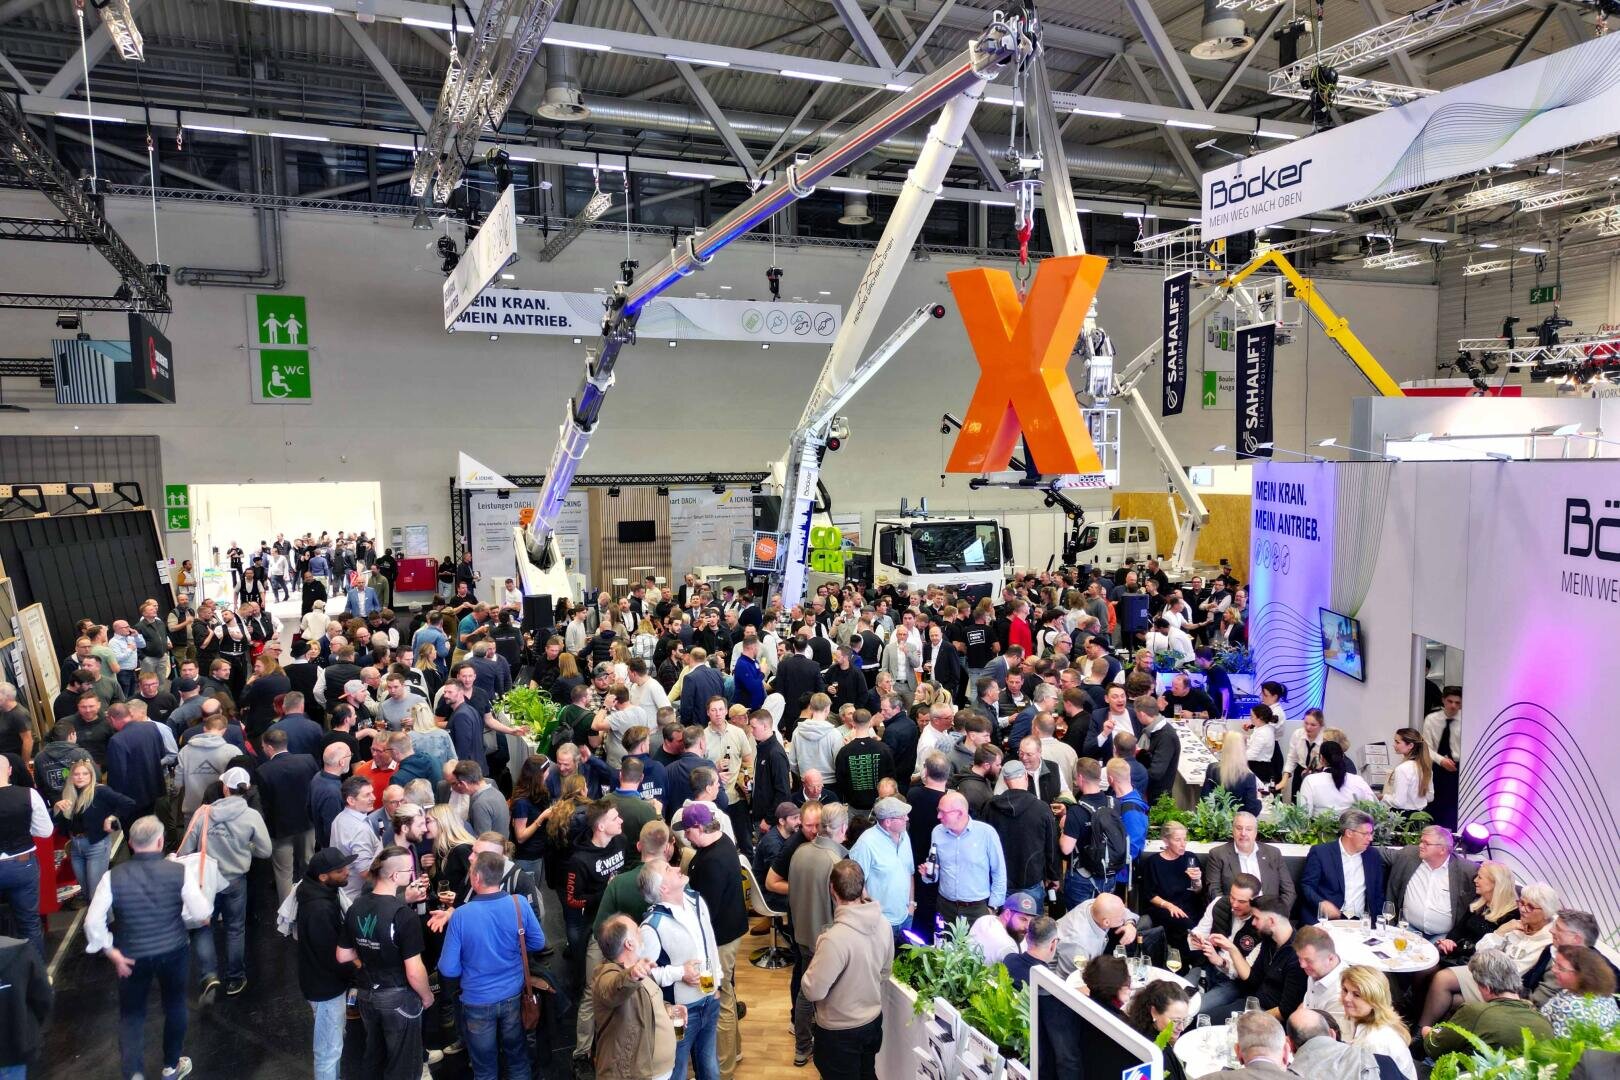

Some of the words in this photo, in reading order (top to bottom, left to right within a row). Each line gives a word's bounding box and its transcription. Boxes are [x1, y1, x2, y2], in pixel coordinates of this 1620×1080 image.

[1210, 159, 1313, 210] Böcker
[1209, 213, 1229, 228] MEIN
[1231, 207, 1250, 221] WEG
[1251, 199, 1276, 216] NACH
[1278, 191, 1303, 208] OBEN
[502, 296, 550, 311] KRAN.
[503, 313, 572, 328] ANTRIEB.
[1167, 284, 1181, 384] SAHALIFT
[283, 365, 305, 375] WC
[1245, 334, 1260, 429] SAHALIFT
[478, 502, 513, 511] Leistungen
[514, 501, 531, 509] DACH
[1256, 481, 1276, 502] MEIN
[1279, 483, 1306, 506] KRAN.
[1255, 509, 1275, 532] MEIN
[1278, 513, 1320, 542] ANTRIEB.
[1561, 570, 1594, 598] MEIN
[1597, 576, 1620, 603] WE
